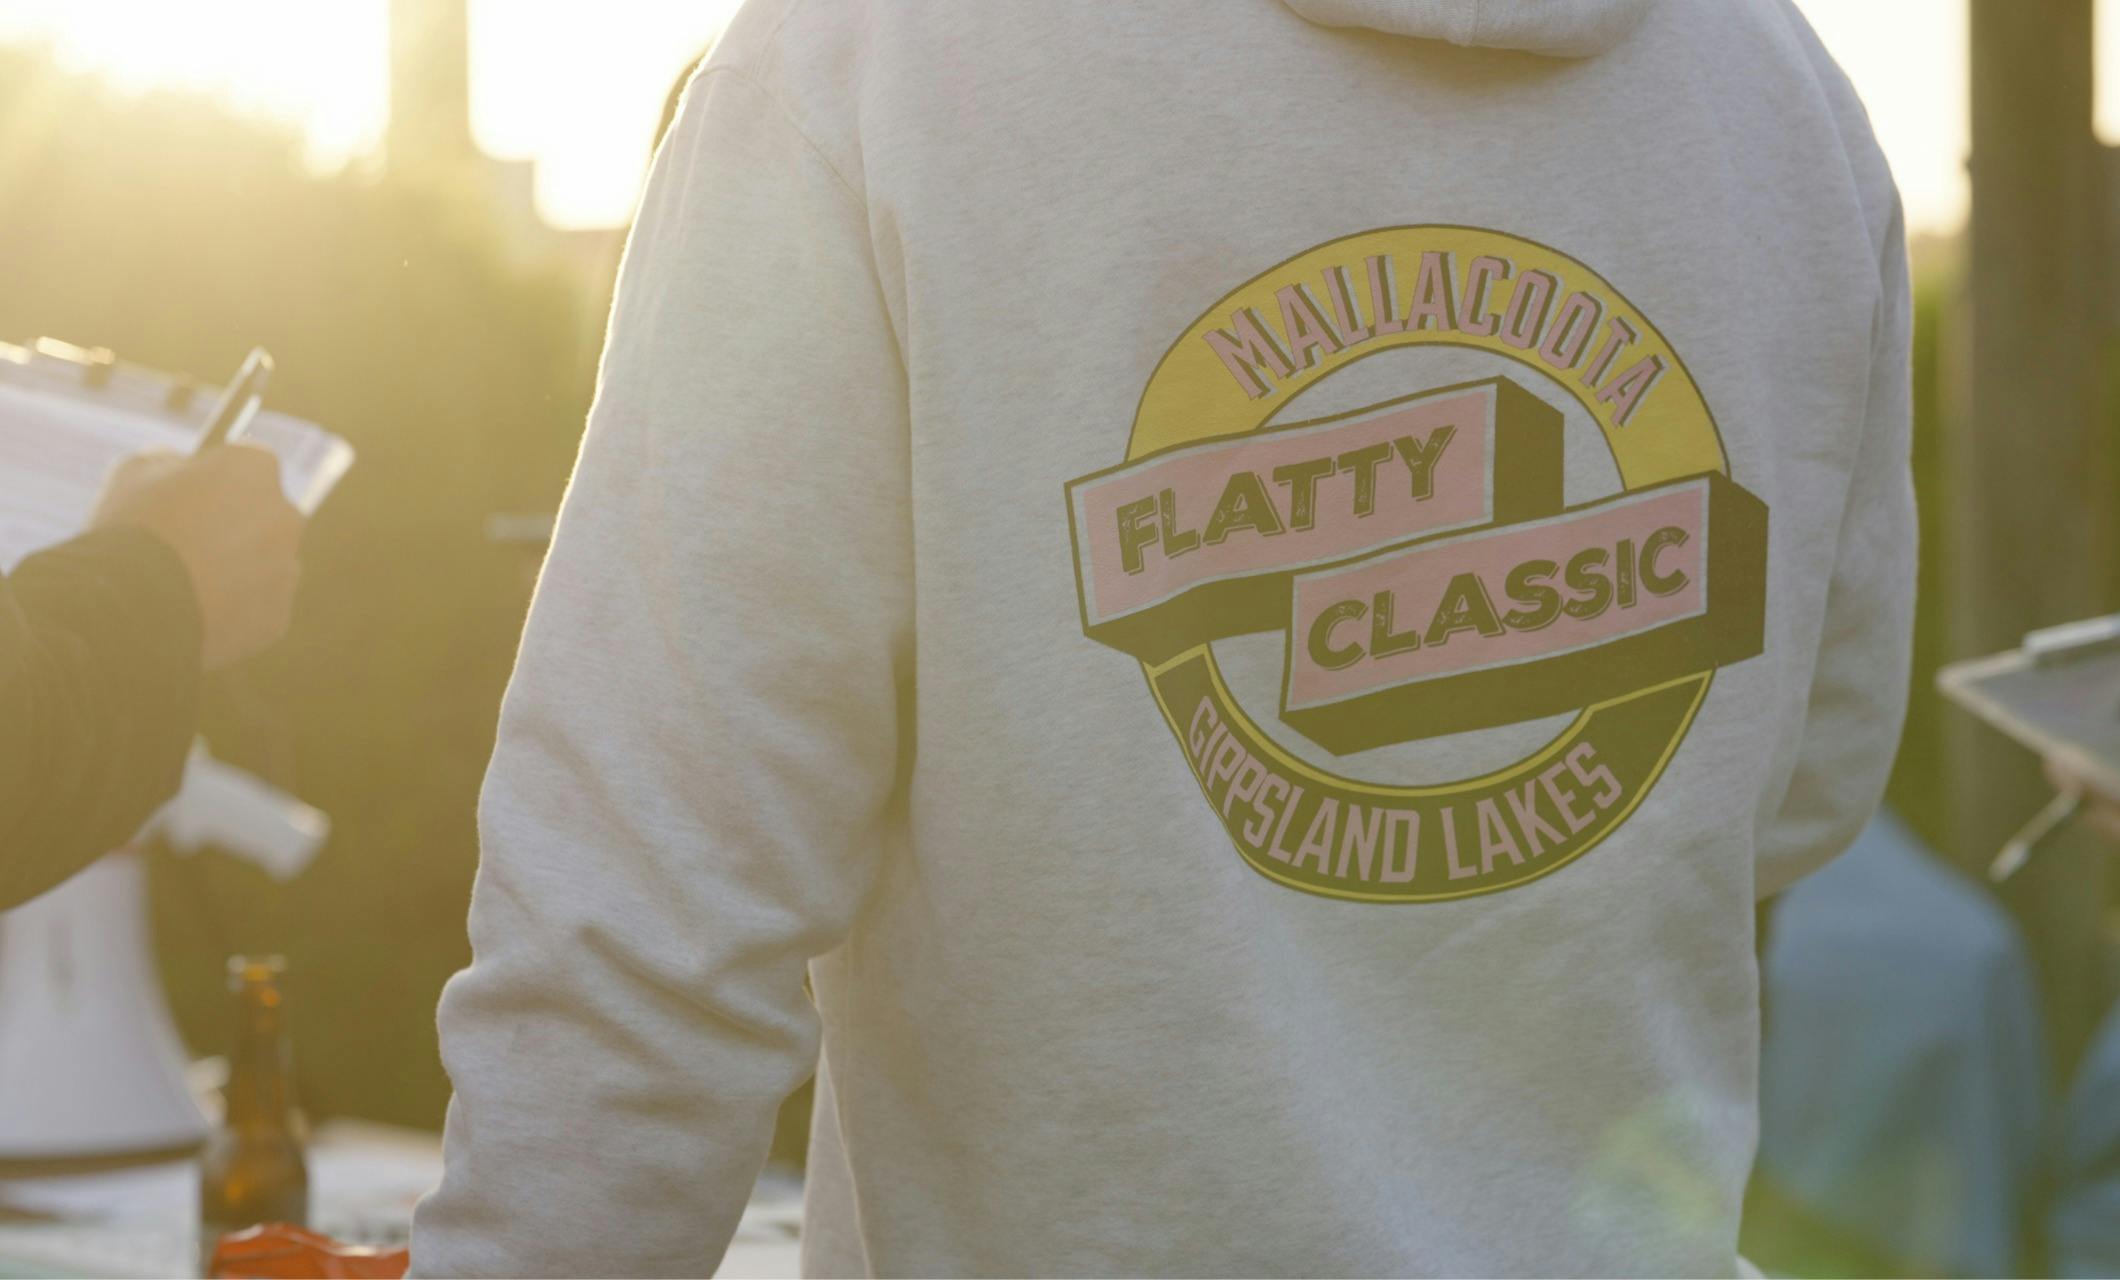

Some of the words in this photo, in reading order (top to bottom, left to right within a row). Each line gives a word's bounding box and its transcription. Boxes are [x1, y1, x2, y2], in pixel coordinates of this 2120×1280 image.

[1203, 251, 1671, 429] MALLACOOTA
[1116, 425, 1457, 575] FLATTY
[1307, 526, 1690, 670] CLASSIC
[1189, 696, 1420, 883] GIPPSLAND
[1440, 741, 1622, 880] LAKES
